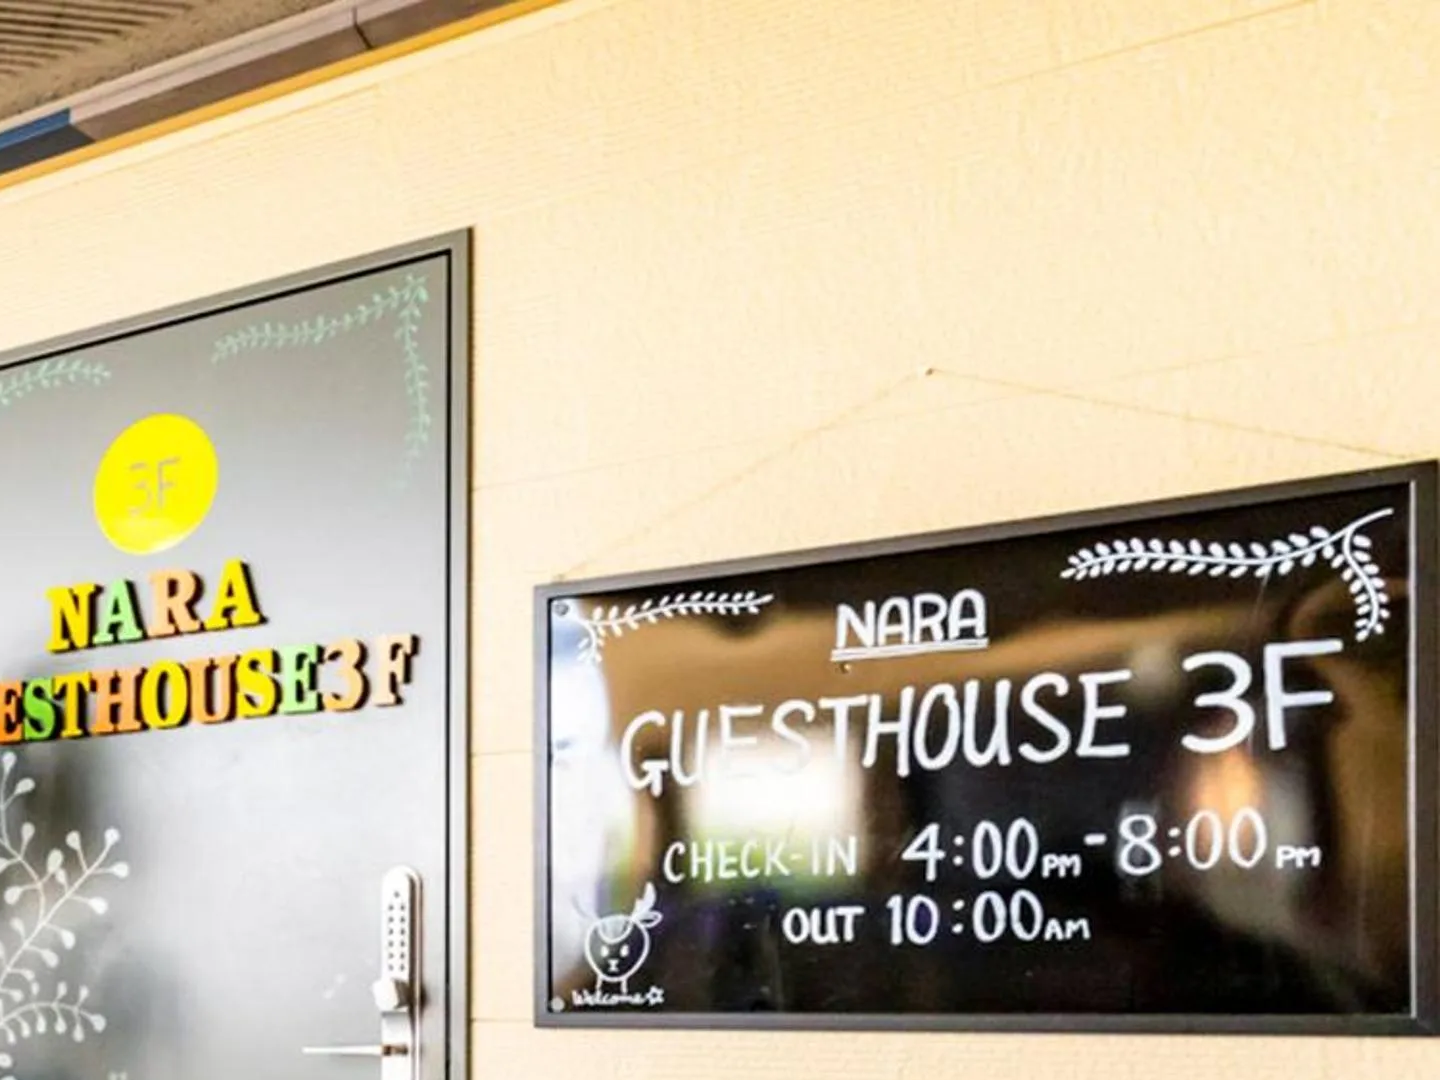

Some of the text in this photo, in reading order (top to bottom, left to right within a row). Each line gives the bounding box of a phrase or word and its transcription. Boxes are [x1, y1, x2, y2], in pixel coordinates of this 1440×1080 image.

[127, 456, 182, 516] 3F
[45, 558, 266, 653] NARA
[835, 589, 988, 650] NARA
[621, 639, 1344, 797] GUESTHOUSE 3F
[663, 836, 858, 884] CHECK-IN
[782, 906, 865, 944] OUT
[571, 989, 646, 1006] Welcome
